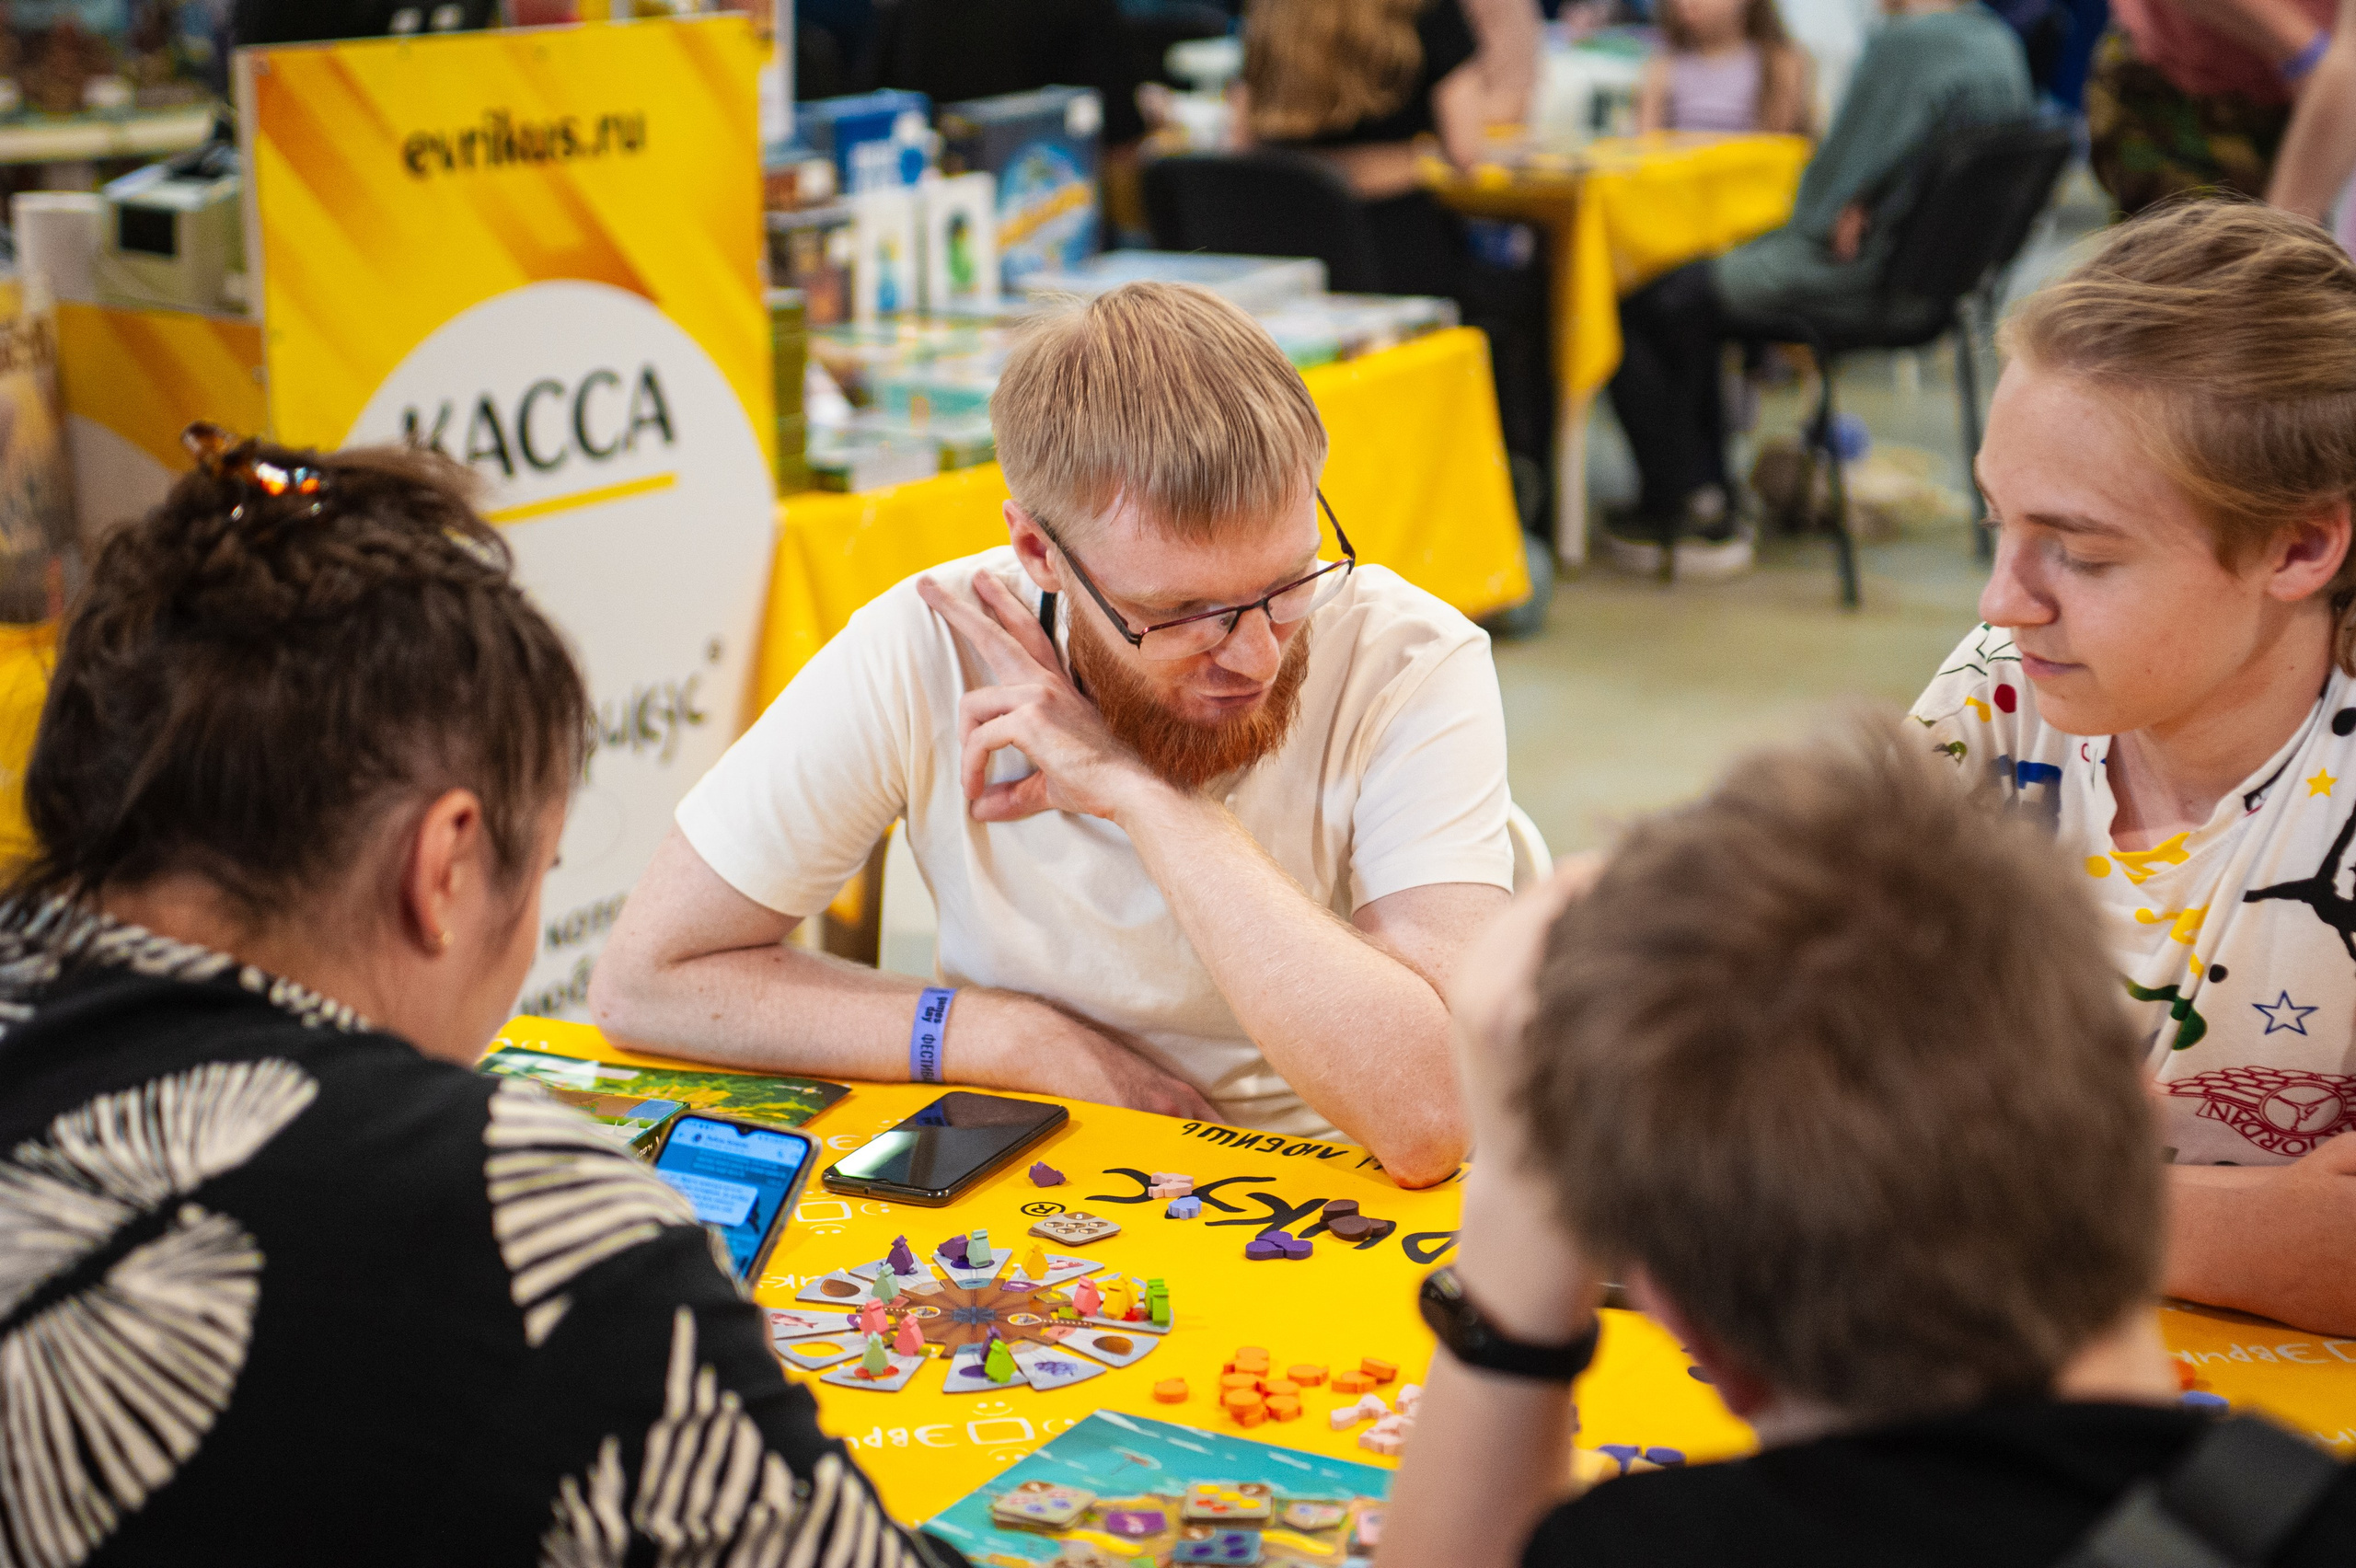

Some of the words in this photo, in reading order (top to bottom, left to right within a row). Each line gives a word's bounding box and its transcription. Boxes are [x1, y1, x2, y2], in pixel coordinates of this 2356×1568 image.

[401, 107, 647, 178] evrikus.ru
[402, 363, 674, 478] КАССА
[920, 1034, 936, 1082] ФЕСТИВА
[2167, 1341, 2330, 1366] Эврик
